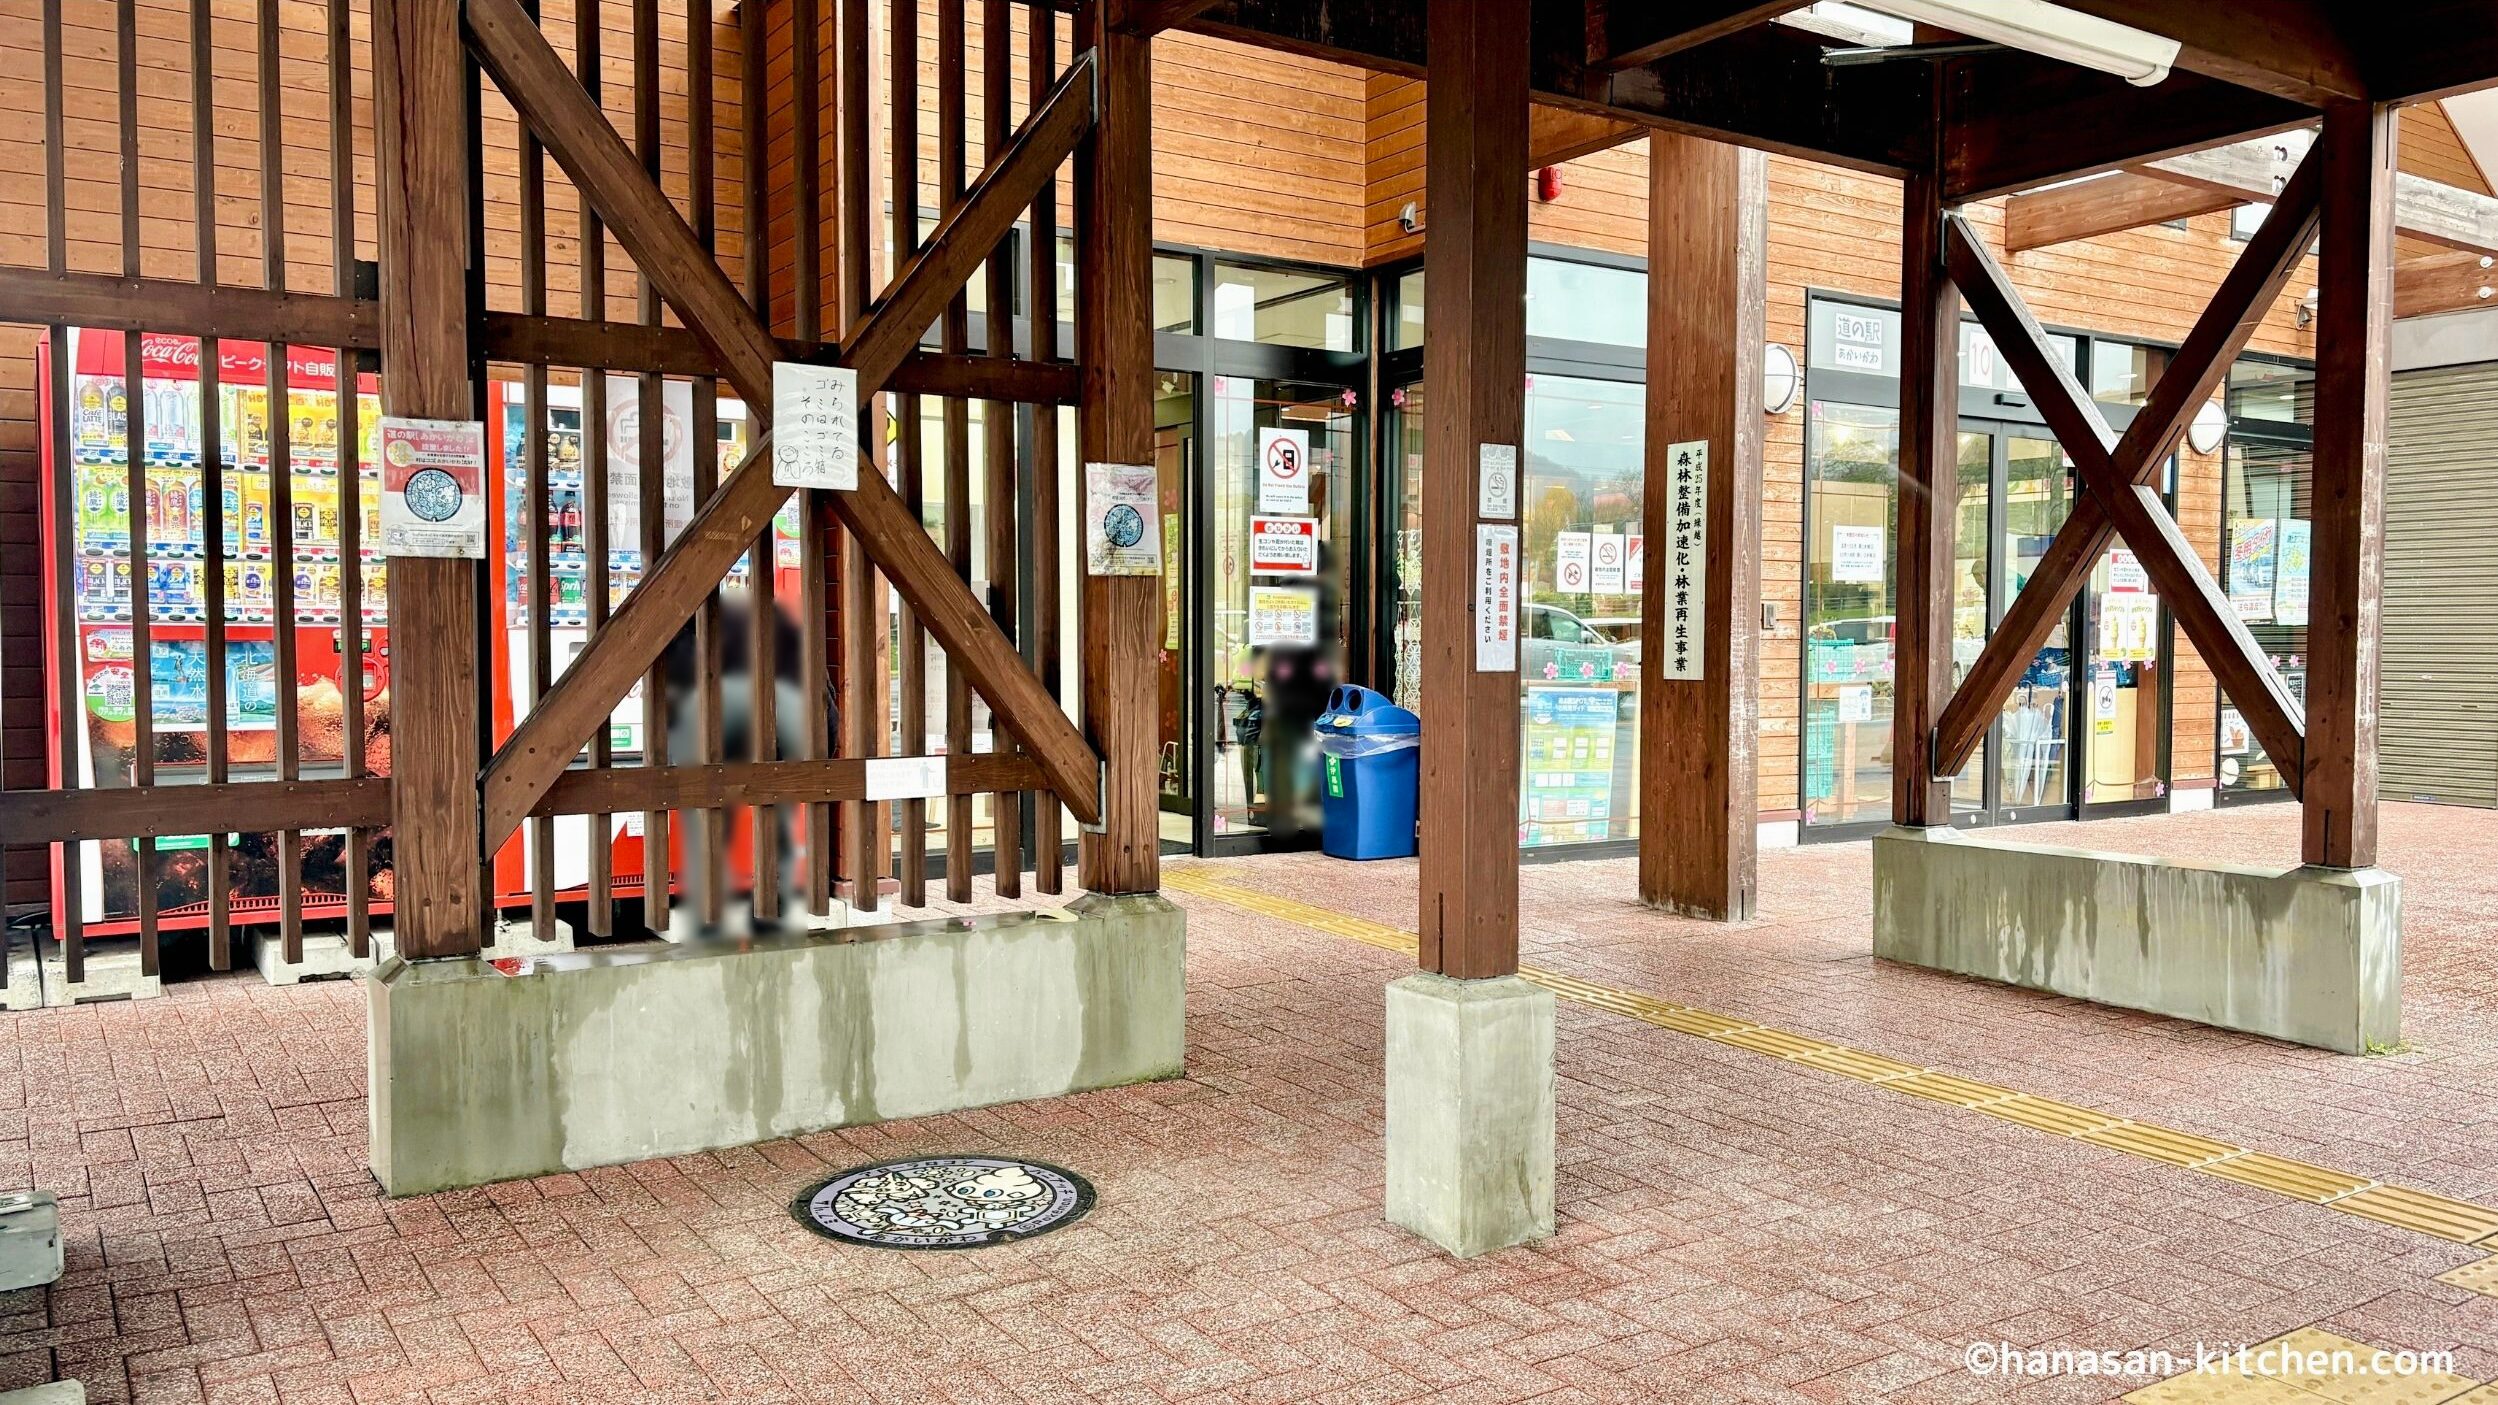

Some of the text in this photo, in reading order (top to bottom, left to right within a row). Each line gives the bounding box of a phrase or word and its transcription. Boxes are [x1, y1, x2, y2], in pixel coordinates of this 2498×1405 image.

[1838, 316, 1880, 341] 道の駅
[1839, 348, 1879, 364] あかいがわ
[1674, 451, 1692, 672] 森林整備加速化・林業再生事業
[1498, 542, 1510, 641] 敷地内全面禁煙
[188, 652, 205, 699] 天然水
[242, 650, 258, 711] 北海道の
